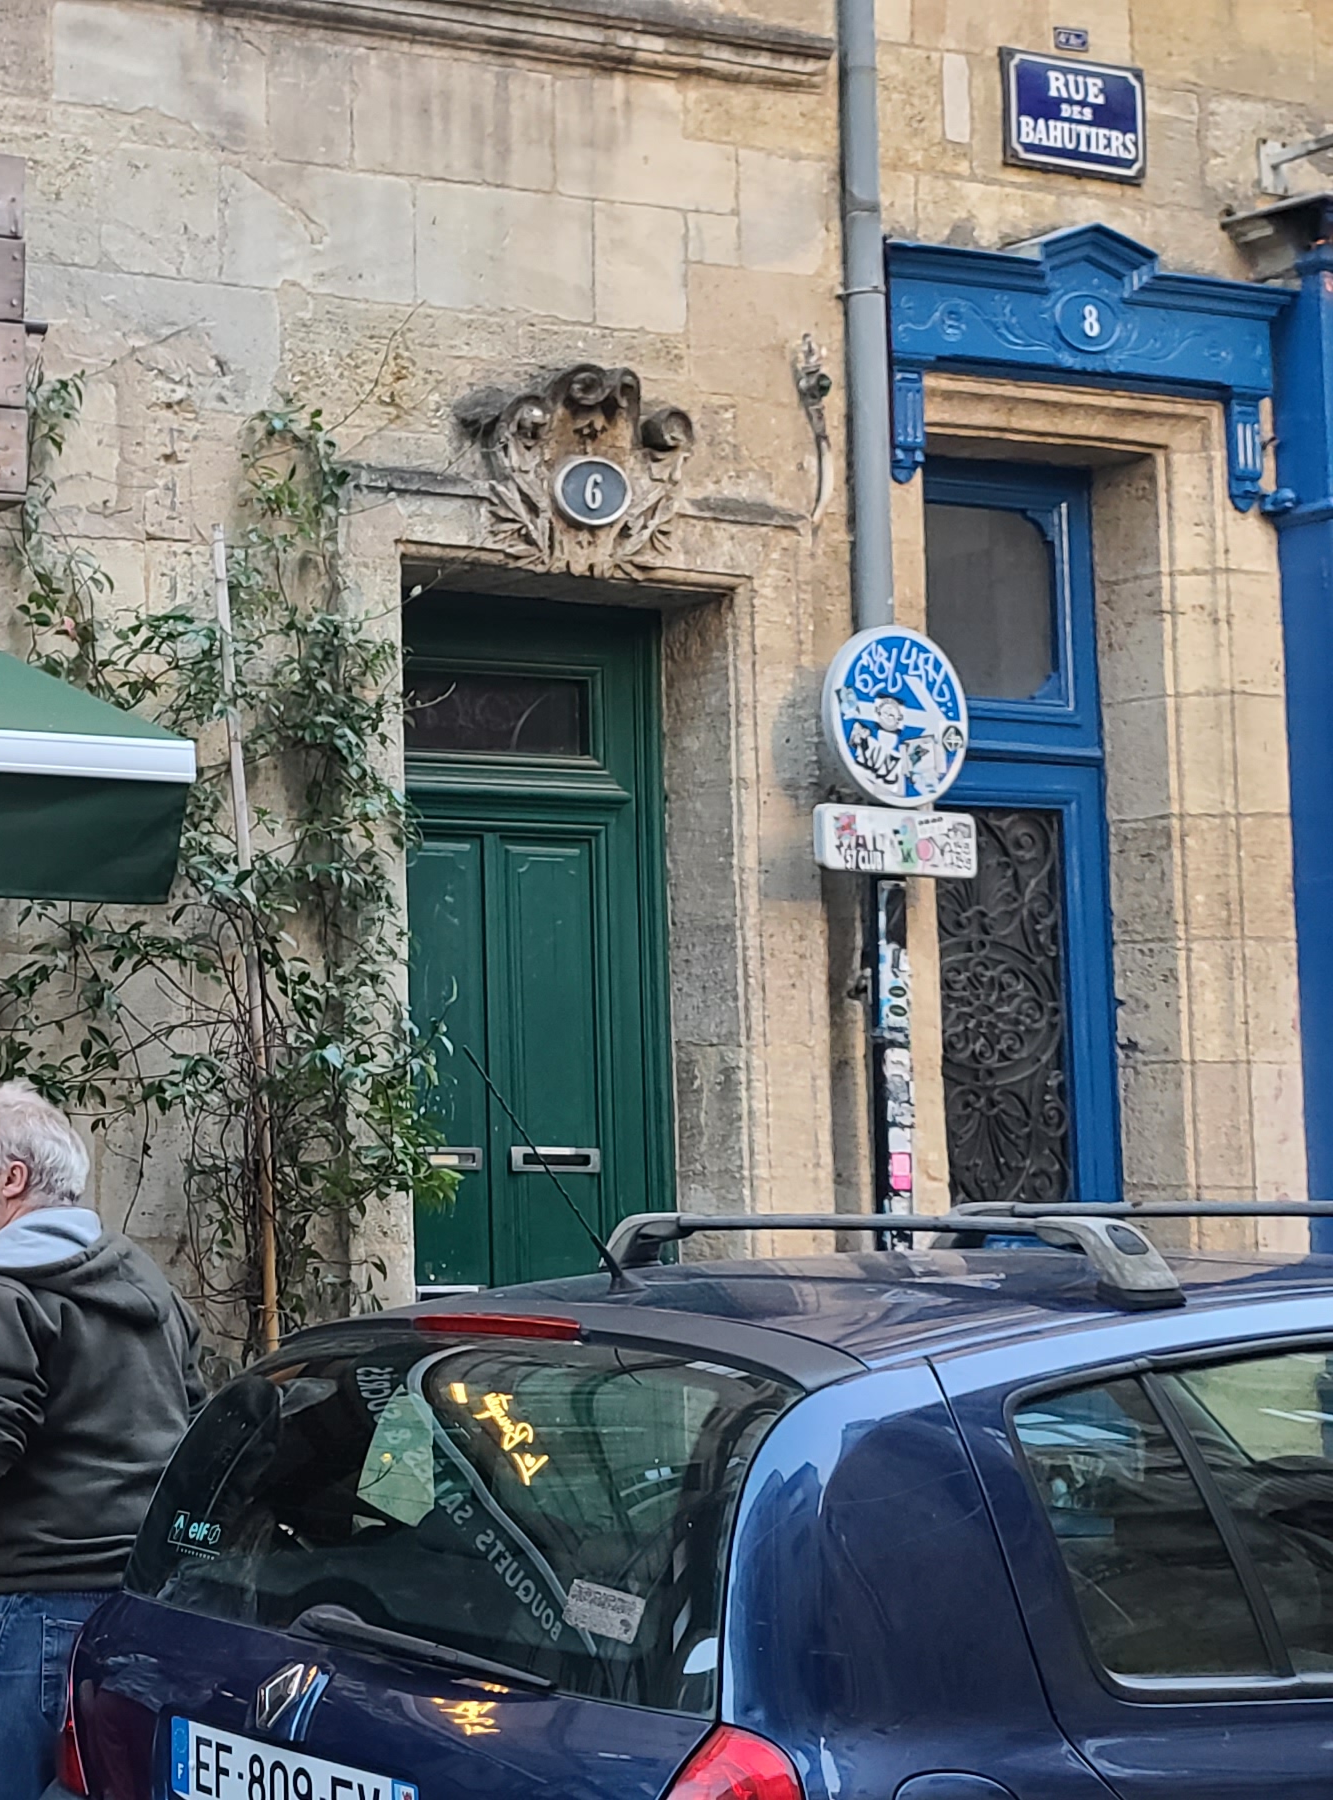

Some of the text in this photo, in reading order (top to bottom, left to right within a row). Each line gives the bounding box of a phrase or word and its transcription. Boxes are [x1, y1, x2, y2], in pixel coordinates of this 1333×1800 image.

[1047, 70, 1106, 104] RUE
[1060, 103, 1093, 120] DES
[1019, 115, 1136, 159] BAHUTIERS
[1083, 304, 1101, 337] 8
[585, 473, 603, 509] 6
[188, 1521, 211, 1542] elf
[177, 1763, 184, 1780] F
[195, 1735, 381, 1800] EF-809
